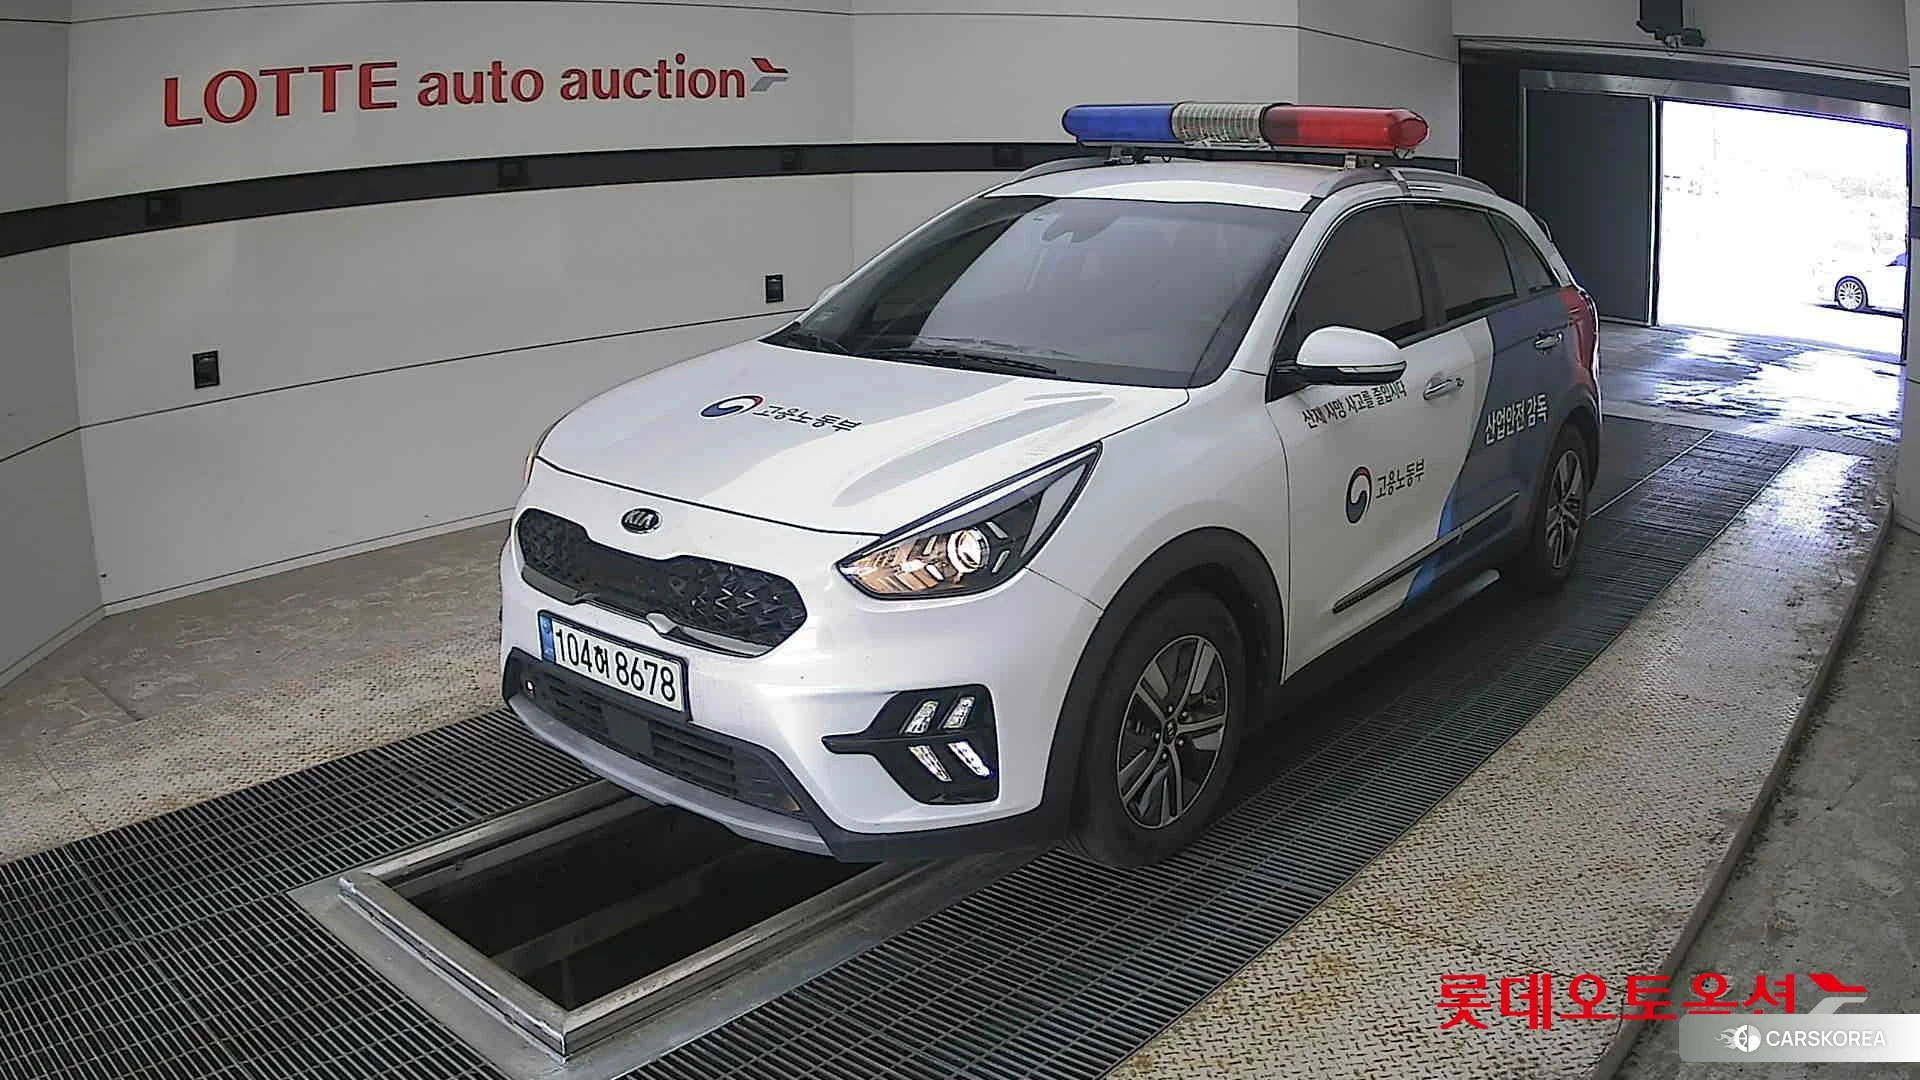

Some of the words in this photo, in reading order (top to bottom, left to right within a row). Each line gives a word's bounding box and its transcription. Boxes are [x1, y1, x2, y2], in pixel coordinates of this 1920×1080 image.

[164, 61, 399, 127] LOTTE
[417, 60, 545, 107] auto
[560, 52, 745, 101] auction
[753, 405, 862, 432] 고용노동부
[1324, 399, 1347, 419] 사망
[1345, 390, 1375, 414] 사고를
[1485, 400, 1525, 445] 산업안전
[1527, 394, 1548, 428] 감독
[1375, 458, 1425, 499] 고용노동부
[624, 510, 654, 528] KIA
[615, 651, 676, 702] 8678
